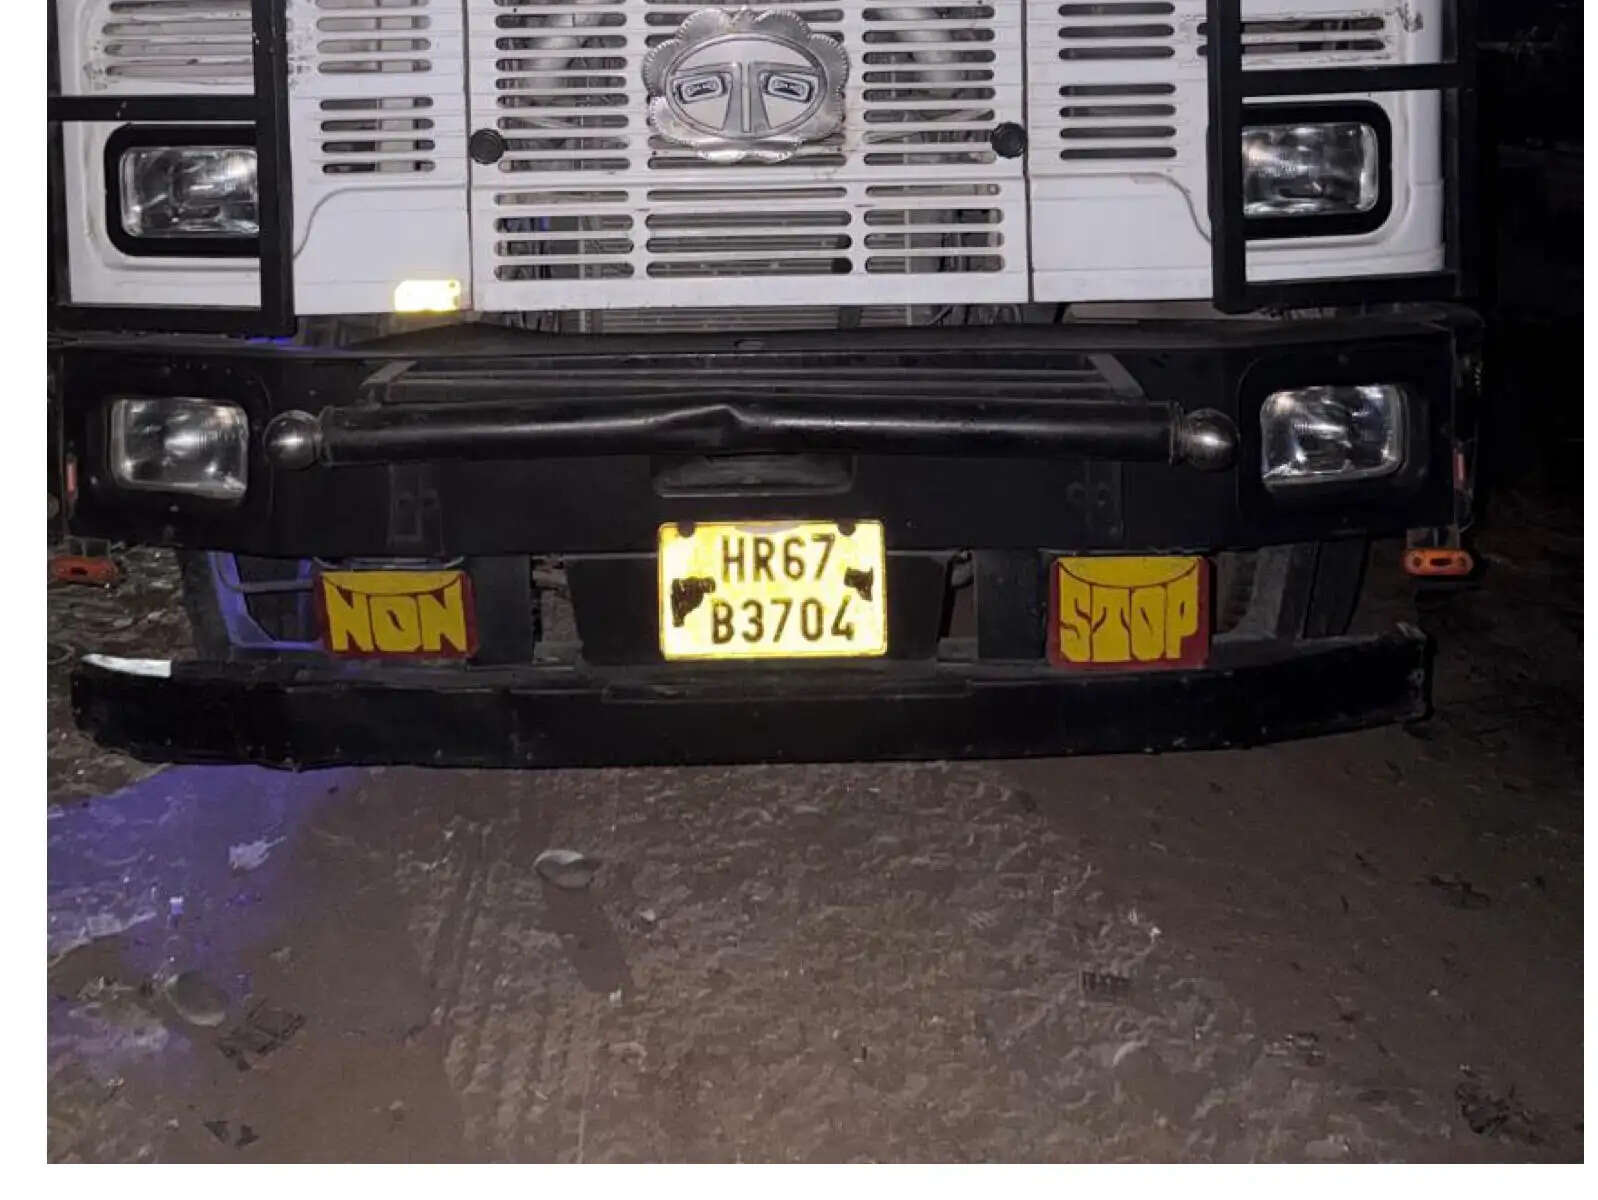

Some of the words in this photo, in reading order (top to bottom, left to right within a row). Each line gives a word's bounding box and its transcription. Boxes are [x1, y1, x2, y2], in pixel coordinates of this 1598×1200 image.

[721, 532, 836, 583] HR67
[324, 579, 468, 652] NON
[711, 596, 855, 645] B3704
[1059, 572, 1199, 662] STOP
